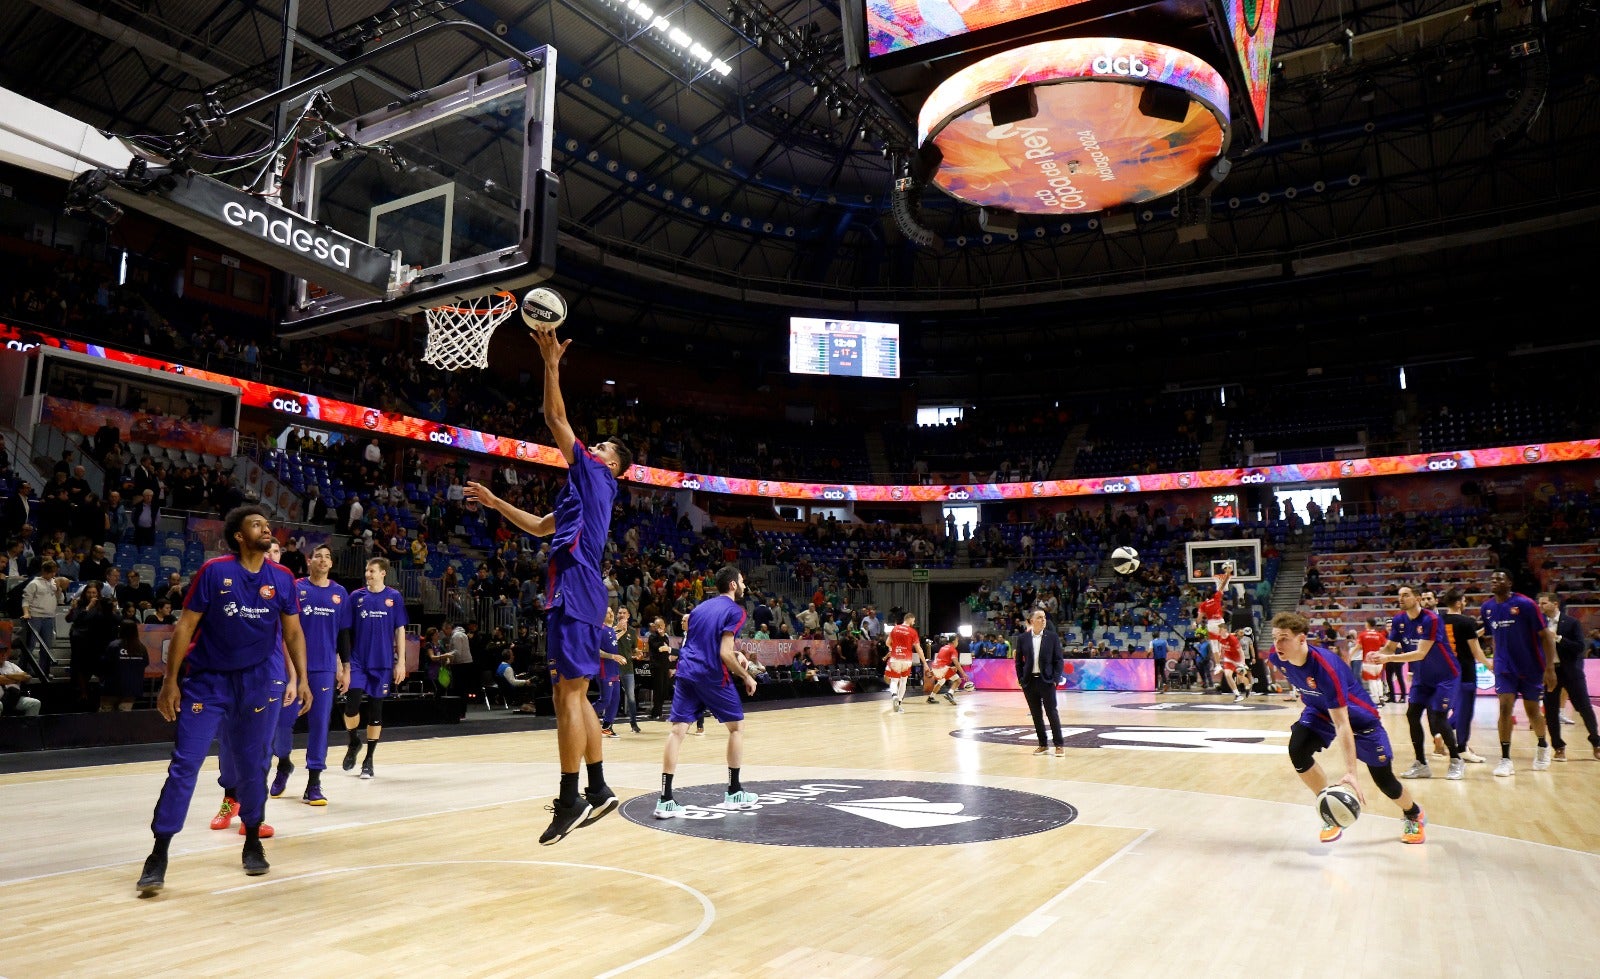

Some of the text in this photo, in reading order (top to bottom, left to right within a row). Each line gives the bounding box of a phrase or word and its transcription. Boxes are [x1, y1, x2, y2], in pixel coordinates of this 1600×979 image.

[1092, 54, 1149, 77] acb
[1016, 126, 1087, 210] Copa del Rey
[223, 201, 351, 269] endesa
[7, 340, 40, 352] ac
[273, 398, 302, 414] acb
[429, 431, 453, 445] acb
[1428, 459, 1457, 470] acb
[1241, 472, 1266, 484] acb
[682, 479, 701, 490] acb
[1104, 482, 1127, 493] acb
[823, 490, 845, 500] acb
[948, 489, 970, 500] acb
[1214, 505, 1234, 518] 24
[778, 642, 792, 653] REY
